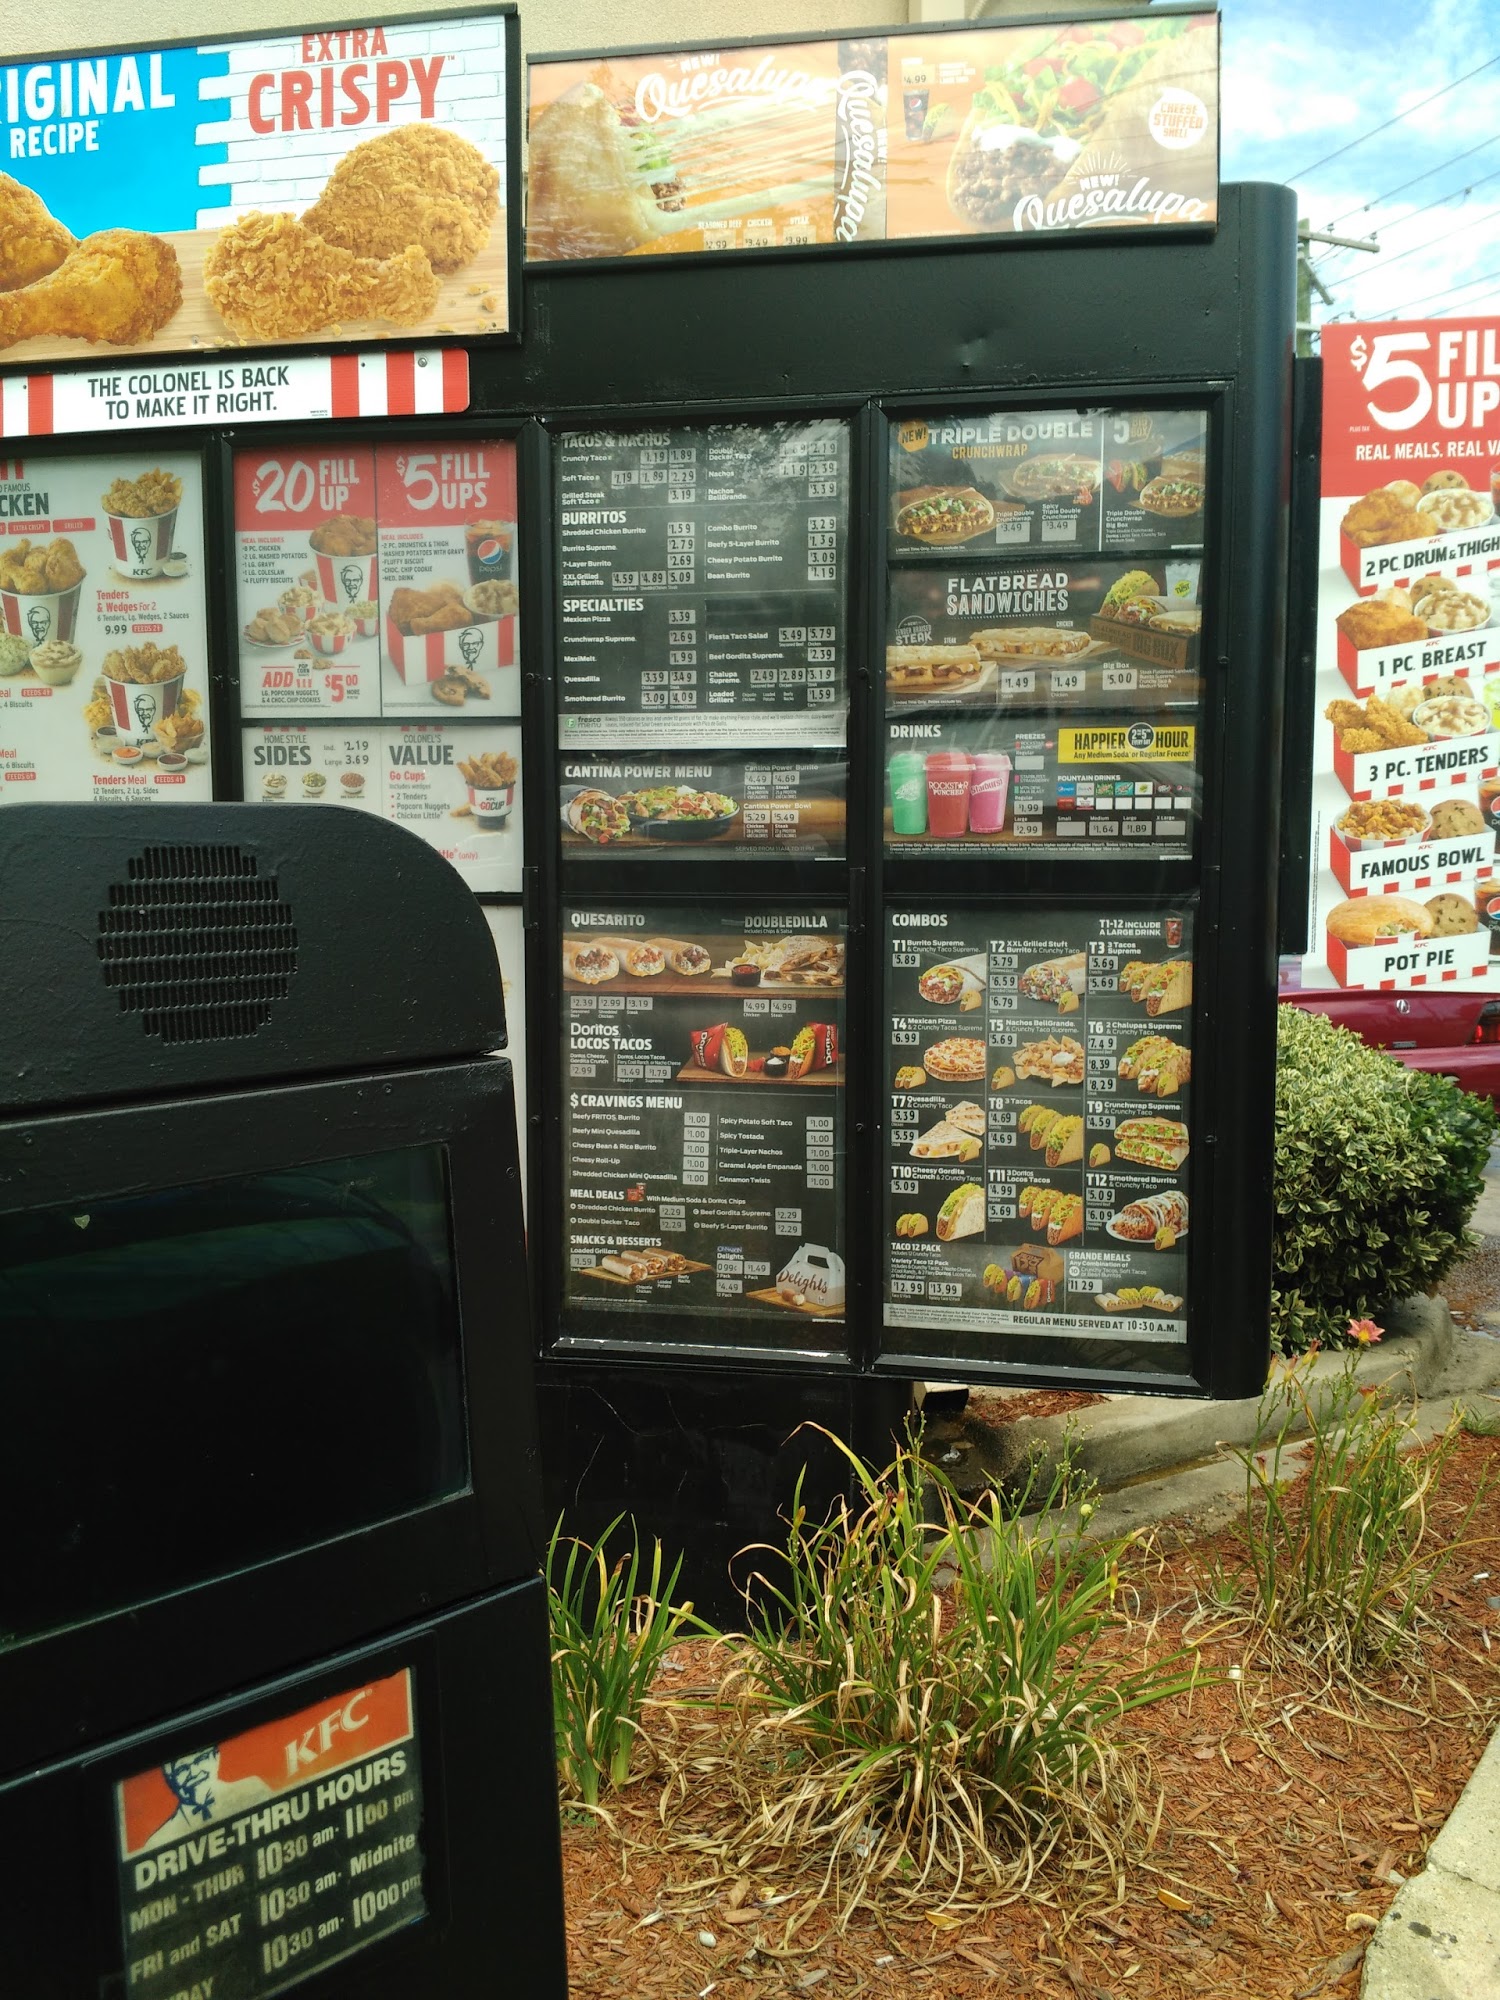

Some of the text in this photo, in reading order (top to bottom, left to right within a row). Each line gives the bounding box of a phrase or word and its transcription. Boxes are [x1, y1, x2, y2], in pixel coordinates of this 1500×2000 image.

[302, 26, 387, 63] EXTRA
[0, 54, 175, 123] IGINAL
[248, 56, 445, 134] CRISPY
[10, 120, 99, 159] RECIPE
[1080, 174, 1119, 191] NEW!
[1013, 177, 1208, 231] Quesalupa
[88, 365, 289, 399] THE COLONEL IS BACK
[105, 391, 278, 421] TO MAKE IT RIGHT.
[902, 422, 1093, 445] NEW! TRIPLE DOUBLE
[952, 444, 1027, 460] CRUNCHWRAP
[1356, 444, 1391, 460] REAL
[1395, 442, 1443, 459] MEALS.
[1448, 441, 1483, 457] REAL
[319, 459, 359, 484] FILL
[442, 453, 490, 480] FILL
[4, 483, 30, 492] FAMOUS
[320, 486, 348, 511] UP
[442, 482, 488, 509] UPS
[562, 511, 626, 525] BURRITOS
[1366, 561, 1375, 577] 2
[1404, 547, 1448, 569] DRUM
[1449, 550, 1456, 560] &
[133, 568, 153, 576] KFC
[948, 573, 1069, 593] FLATBREAD
[97, 590, 129, 599] Tenders
[97, 602, 156, 613] & Wedges For 2
[563, 599, 644, 612] SPECIALTIES
[947, 590, 1069, 616] SANDWICHES
[105, 625, 127, 635] 9.99
[896, 633, 932, 645] STEAK
[1379, 661, 1384, 676] 1
[1422, 641, 1487, 668] BREAST
[263, 672, 294, 687] ADD
[890, 725, 941, 738] DRINKS
[1074, 731, 1189, 750] HAPPIER HOUR
[254, 745, 312, 766] SIDES
[389, 745, 454, 765] VALUE
[1370, 765, 1378, 781] 3
[1415, 746, 1488, 774] TENDERS
[390, 771, 425, 782] Go Cups
[565, 765, 712, 778] CANTINA POWER MENU
[93, 775, 146, 784] Tenders Meal
[1361, 847, 1485, 879] FAMOUS BOWL
[571, 913, 645, 927] QUESARITO
[744, 915, 828, 928] DOUBLEDILLA
[892, 914, 948, 926] COMBOS
[893, 940, 906, 951] T1
[990, 941, 1005, 952] T2
[1089, 942, 1105, 954] T3
[1385, 949, 1454, 972] POT PIE
[570, 1022, 619, 1036] Doritos
[892, 1018, 907, 1030] T4
[989, 1020, 1003, 1031] T5
[1088, 1022, 1103, 1034] T6
[570, 1037, 652, 1050] LOCOS TACOS
[570, 1092, 682, 1109] $ CRAVINGS MENU
[891, 1096, 906, 1108] T7
[988, 1098, 1003, 1110] T8
[1087, 1101, 1103, 1113] T9
[891, 1166, 911, 1178] T10
[988, 1170, 1005, 1182] T11
[1086, 1174, 1107, 1186] T12
[570, 1189, 624, 1200] MEAL DEALS
[570, 1235, 661, 1247] SNACKS & DESSERTS
[891, 1242, 910, 1251] TACO
[922, 1244, 941, 1252] PACK
[1069, 1252, 1131, 1262] GRANDE MEALS
[1013, 1316, 1177, 1332] REGULAR MENU SERVED AT 10:30 A.M.
[284, 1690, 369, 1777] KFC
[135, 1751, 408, 1891] DRIVE-THRU HOURS
[130, 1894, 178, 1934] MON
[193, 1863, 245, 1902] THUR
[130, 1949, 164, 1984] FRI
[170, 1936, 200, 1966] and
[206, 1914, 241, 1950] SAT
[350, 1834, 415, 1877] Midnite
